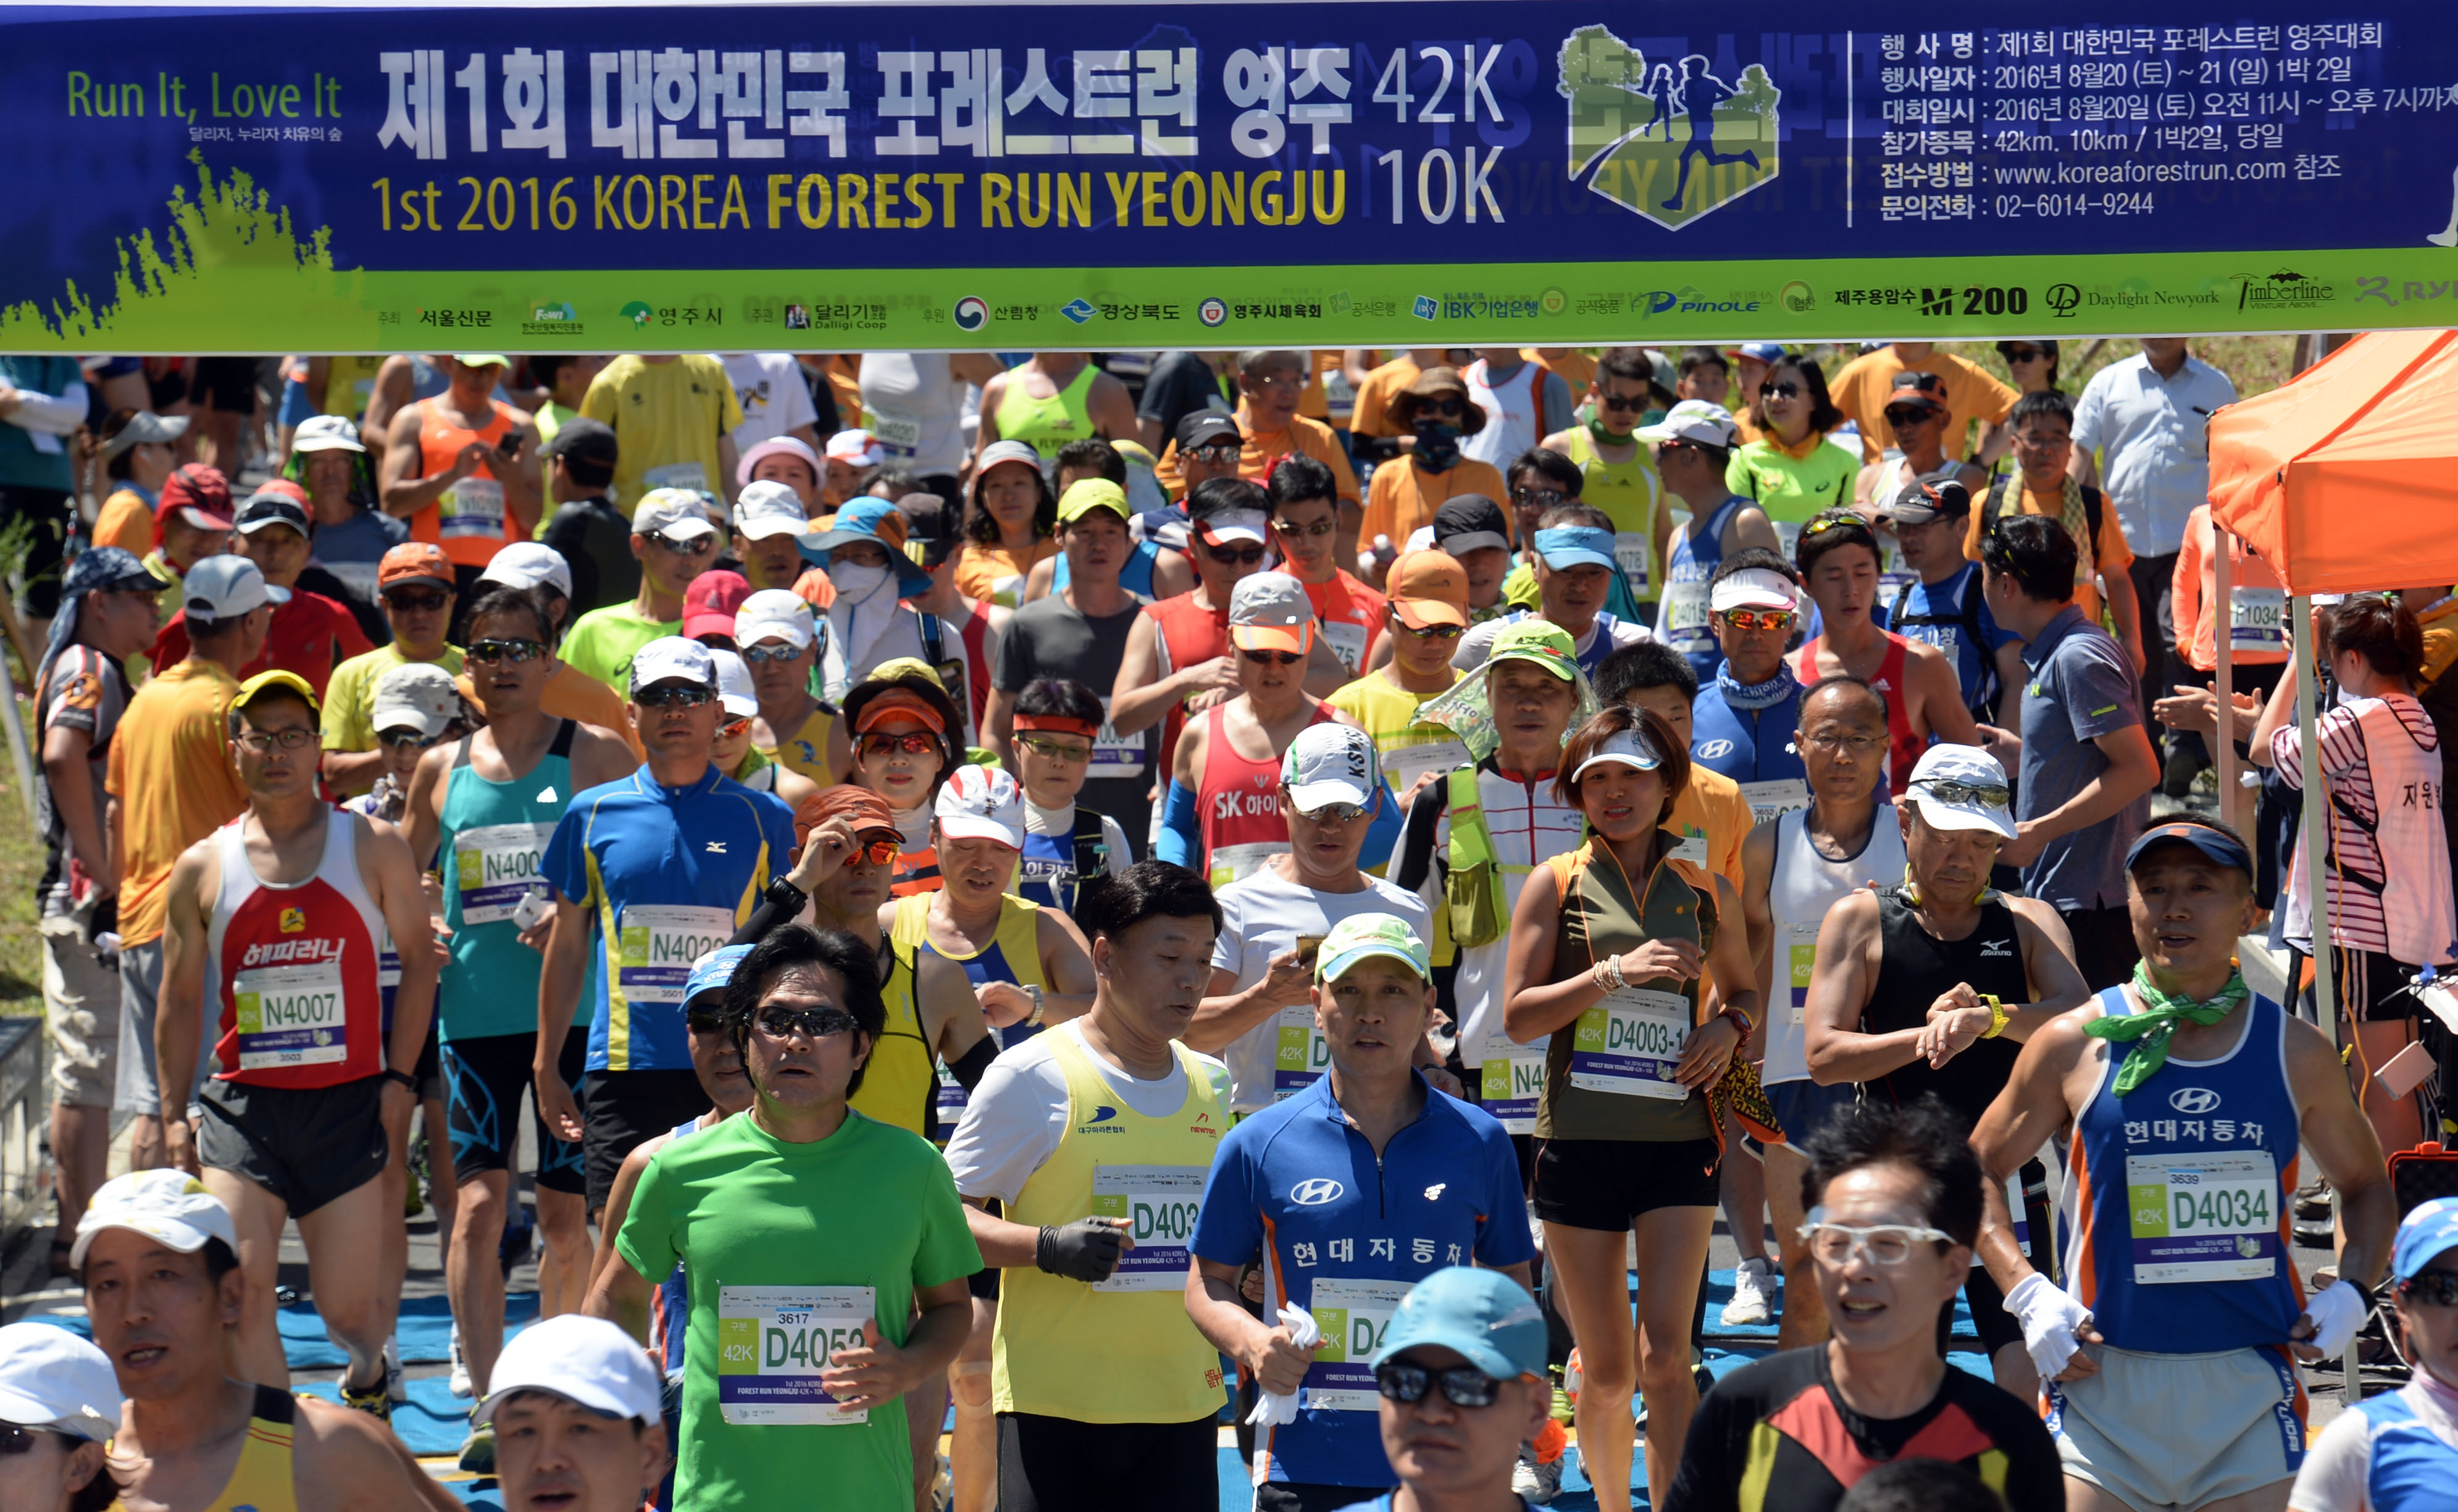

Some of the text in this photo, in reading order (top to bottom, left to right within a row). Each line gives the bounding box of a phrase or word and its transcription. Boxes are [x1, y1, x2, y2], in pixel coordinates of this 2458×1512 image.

[1997, 31, 2054, 57] 제1회
[2063, 29, 2156, 56] 대한민국
[2162, 25, 2280, 52] 포레스트런
[2288, 22, 2382, 51] 영주대회
[1373, 44, 1505, 123] 42K
[1881, 66, 1975, 93] 행사일자
[1995, 64, 2062, 90] 2016년
[2068, 62, 2126, 88] 8월20
[2133, 59, 2172, 88] (토)
[2200, 61, 2220, 83] 21
[2230, 57, 2268, 86] (일)
[2276, 57, 2310, 83] 1박
[2317, 56, 2351, 81] 2일
[68, 71, 341, 125] Run It, Love It
[377, 46, 1352, 159] 제1회 대한민국 포레스트런 영주
[1883, 98, 1974, 124] 대회일시
[1995, 96, 2062, 122] 2016년
[2068, 94, 2149, 120] 8월20일
[2157, 92, 2195, 120] (토)
[2202, 91, 2249, 117] 오전
[2257, 90, 2299, 116] 11시
[2328, 88, 2377, 114] 오후
[238, 127, 279, 142] 누리자
[282, 127, 324, 142] 치유의
[328, 127, 343, 142] 숲
[1881, 130, 1975, 156] 참가종목
[2071, 129, 2127, 150] 10km
[2238, 123, 2283, 149] 당일
[1881, 154, 2342, 188] 접수방법 www.koreaforestrun.com 참조
[1379, 146, 1505, 224] 10K
[372, 169, 1345, 231] 1st 2016 KOREA FOREST RUN YEONGJU
[1880, 192, 2154, 220] 문의전화 02-6014-9244
[1834, 288, 1917, 306] 제주용암수
[1963, 287, 2028, 315] 200
[2088, 291, 2219, 309] Daylight Newyork
[2404, 281, 2458, 301] RY
[420, 309, 492, 327] 서울신문
[659, 307, 722, 326] 영주시
[816, 304, 868, 320] 달리기
[995, 306, 1039, 321] 산림청
[1101, 304, 1181, 321] 경상북도
[1234, 303, 1321, 319] 영주시체육회
[1352, 301, 1396, 317] 공식은행
[815, 320, 887, 331] Dalligi Coop
[1215, 790, 1243, 819] SK
[264, 993, 336, 1027] N4007
[1578, 1027, 1602, 1042] 42K
[1608, 1017, 1684, 1055] D4003-1
[1279, 1046, 1304, 1061] 42K
[1486, 1078, 1508, 1090] 42K
[2123, 1119, 2264, 1147] 현대자동차
[2170, 1174, 2199, 1185] 3639
[2134, 1208, 2164, 1226] 42K
[2173, 1188, 2270, 1229] D4034
[1293, 1238, 1462, 1268] 현대자동차
[778, 1313, 809, 1324] 3617
[723, 1344, 754, 1361] 42K
